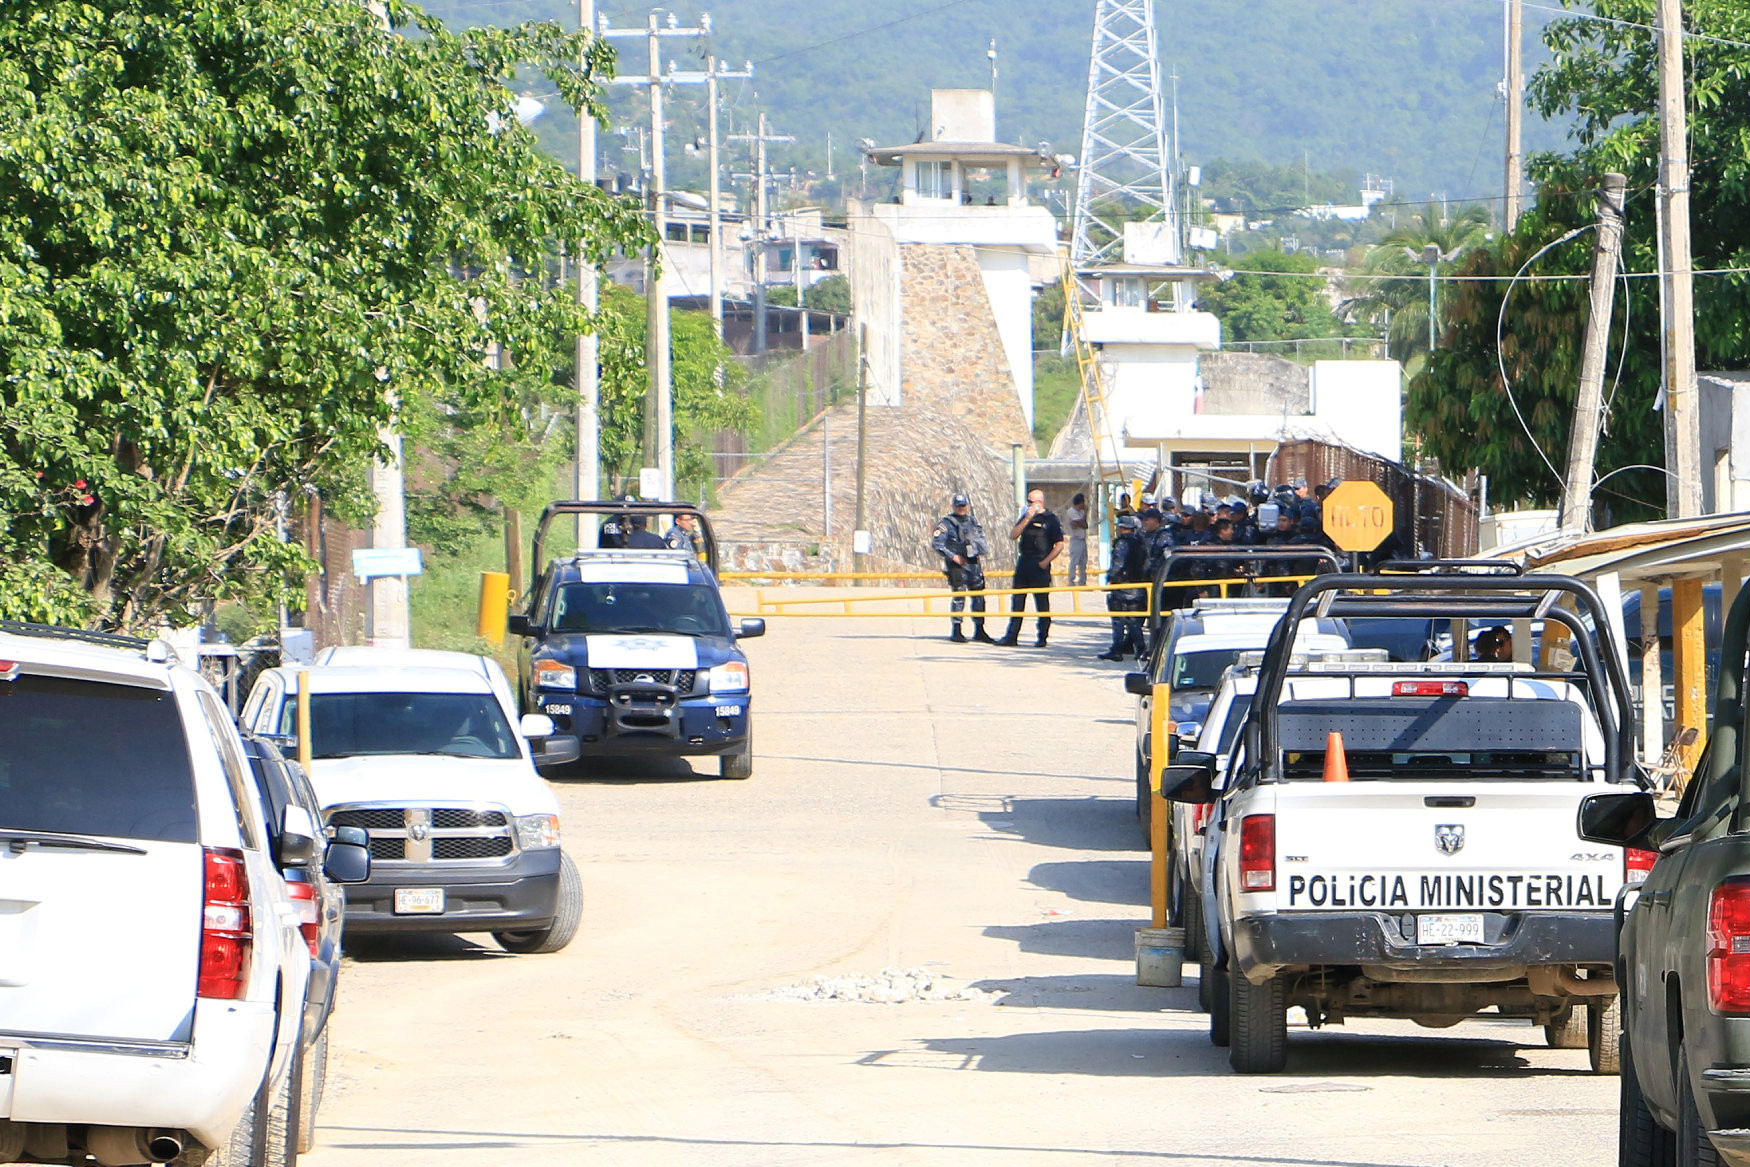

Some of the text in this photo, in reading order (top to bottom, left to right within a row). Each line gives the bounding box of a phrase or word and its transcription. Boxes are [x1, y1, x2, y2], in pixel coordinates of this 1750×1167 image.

[1331, 506, 1385, 528] ALTO
[545, 704, 571, 715] 15849
[714, 705, 741, 716] 15849
[1420, 875, 1612, 906] MINISTERIAL
[1422, 923, 1479, 937] HE-22-999
